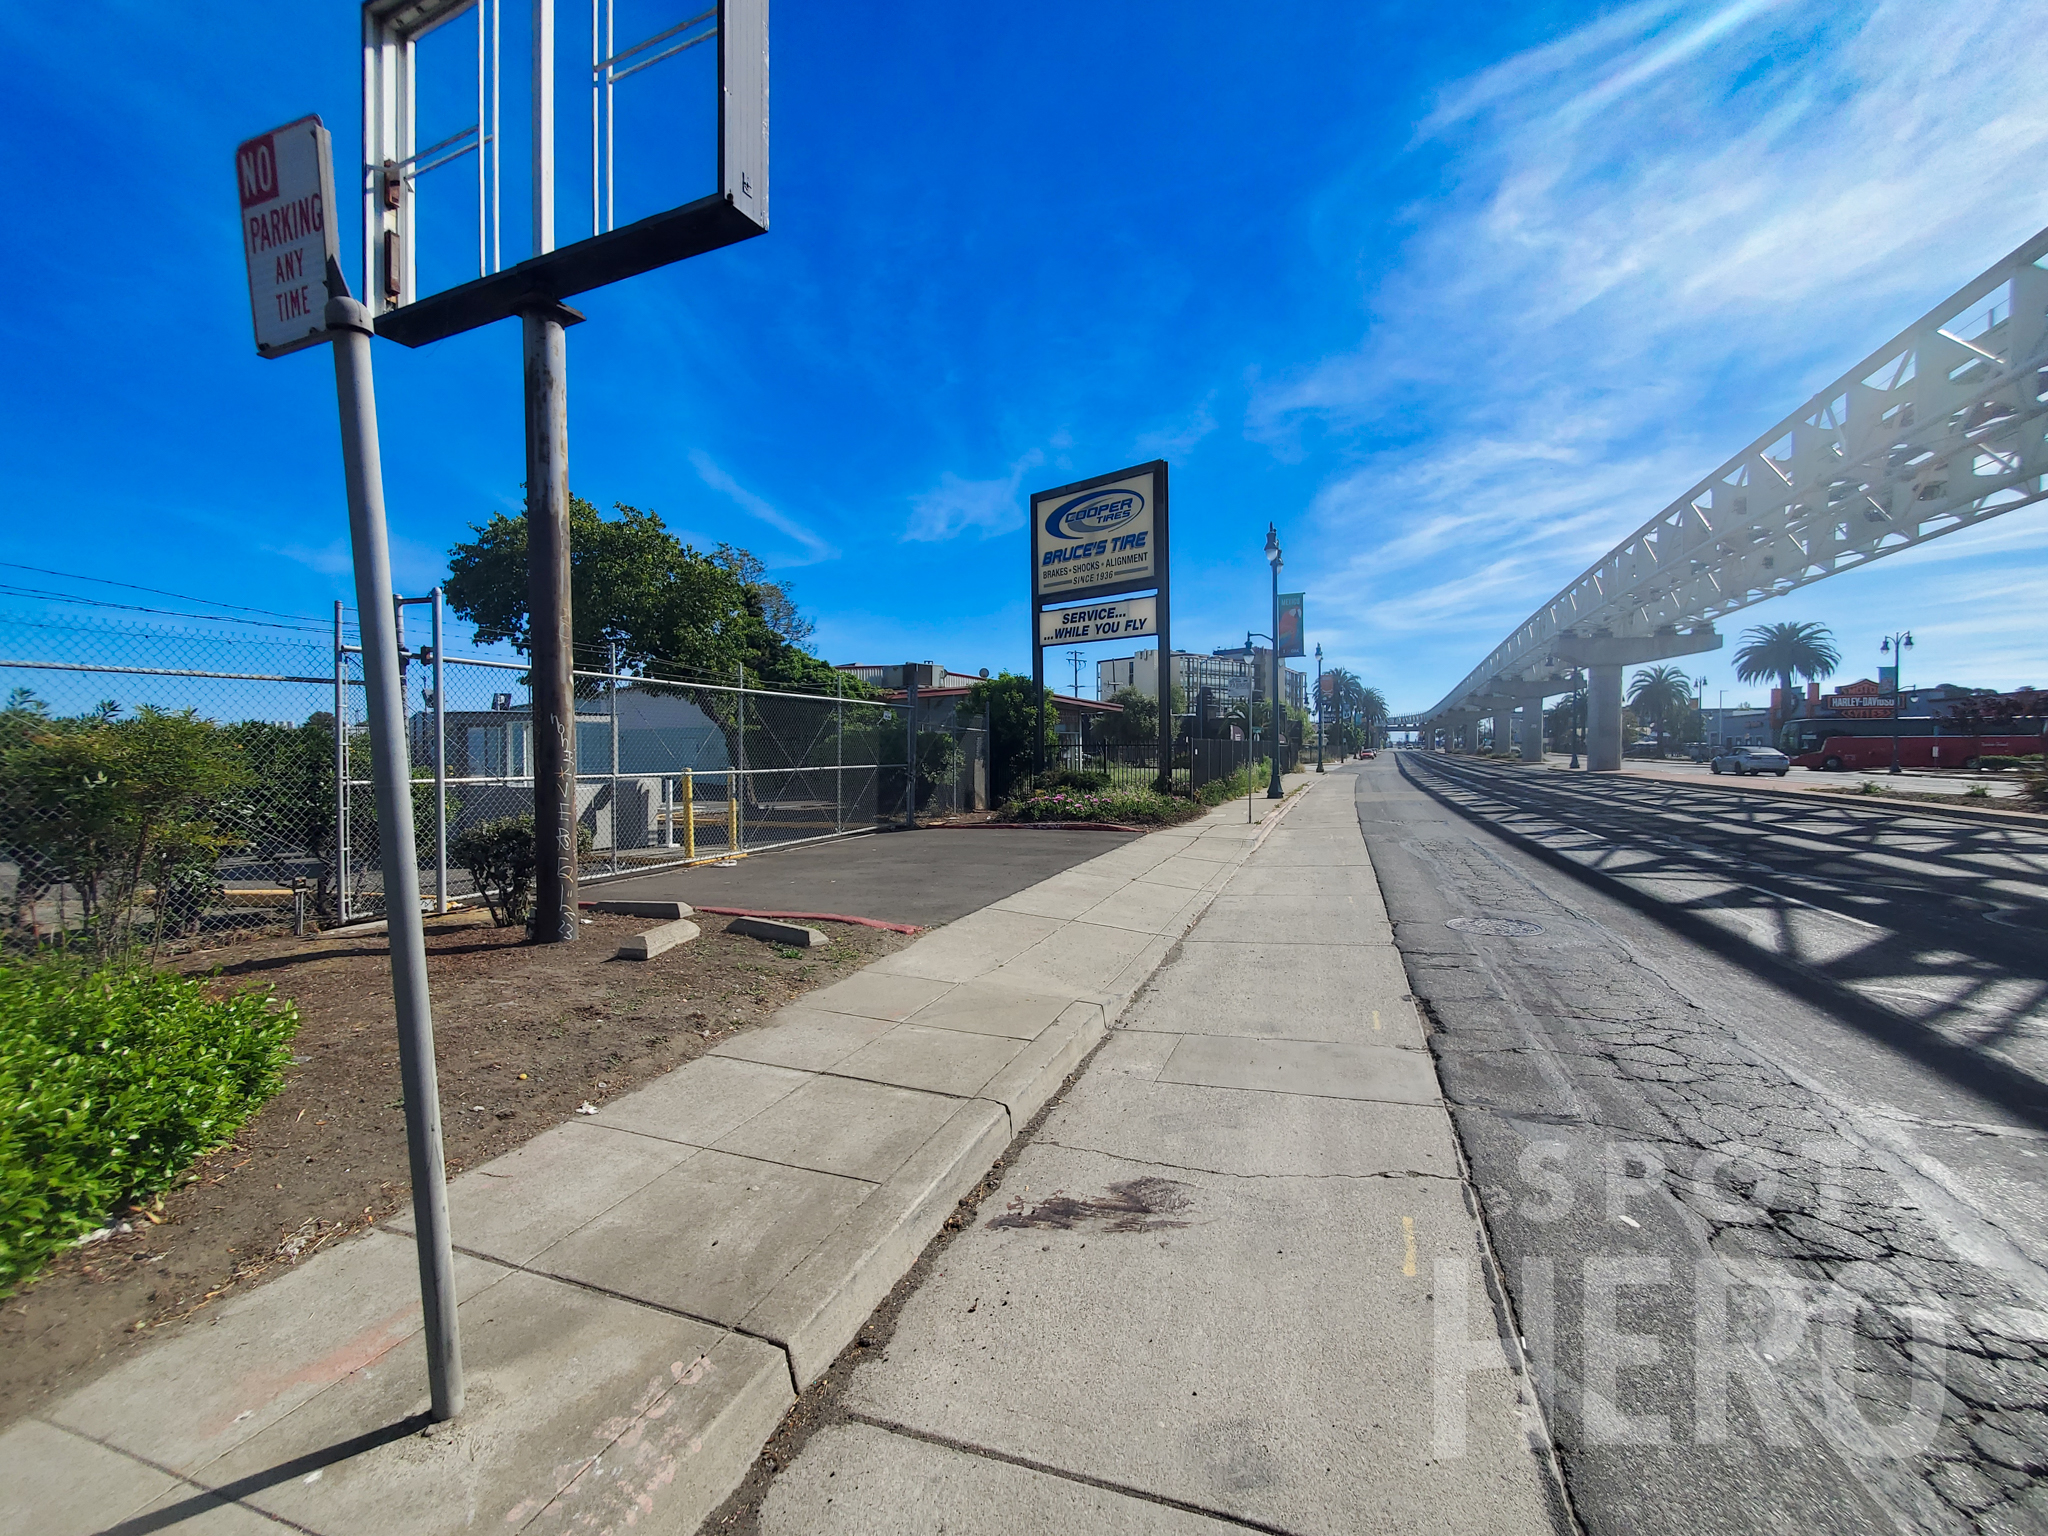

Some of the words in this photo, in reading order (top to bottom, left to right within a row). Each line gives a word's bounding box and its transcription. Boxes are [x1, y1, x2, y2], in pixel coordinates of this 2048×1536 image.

[240, 145, 273, 200] NO
[249, 193, 323, 254] PARKING
[275, 248, 304, 285] ANY
[275, 285, 311, 322] TIME
[1065, 499, 1133, 523] COOPER
[1096, 509, 1131, 524] TIRES
[1042, 540, 1108, 567] BRUCE'S
[1110, 531, 1149, 554] TIRE
[1042, 568, 1068, 580] BRAKES
[1072, 560, 1100, 574] SHOCKS
[1105, 552, 1149, 568] ALIGNMENT
[1072, 573, 1095, 585] SINCE
[1096, 570, 1114, 582] 1936
[1043, 624, 1090, 641] ...WHILE
[1095, 621, 1120, 635] YOU
[1125, 618, 1147, 632] FLY
[1062, 607, 1126, 625] SERVICE...
